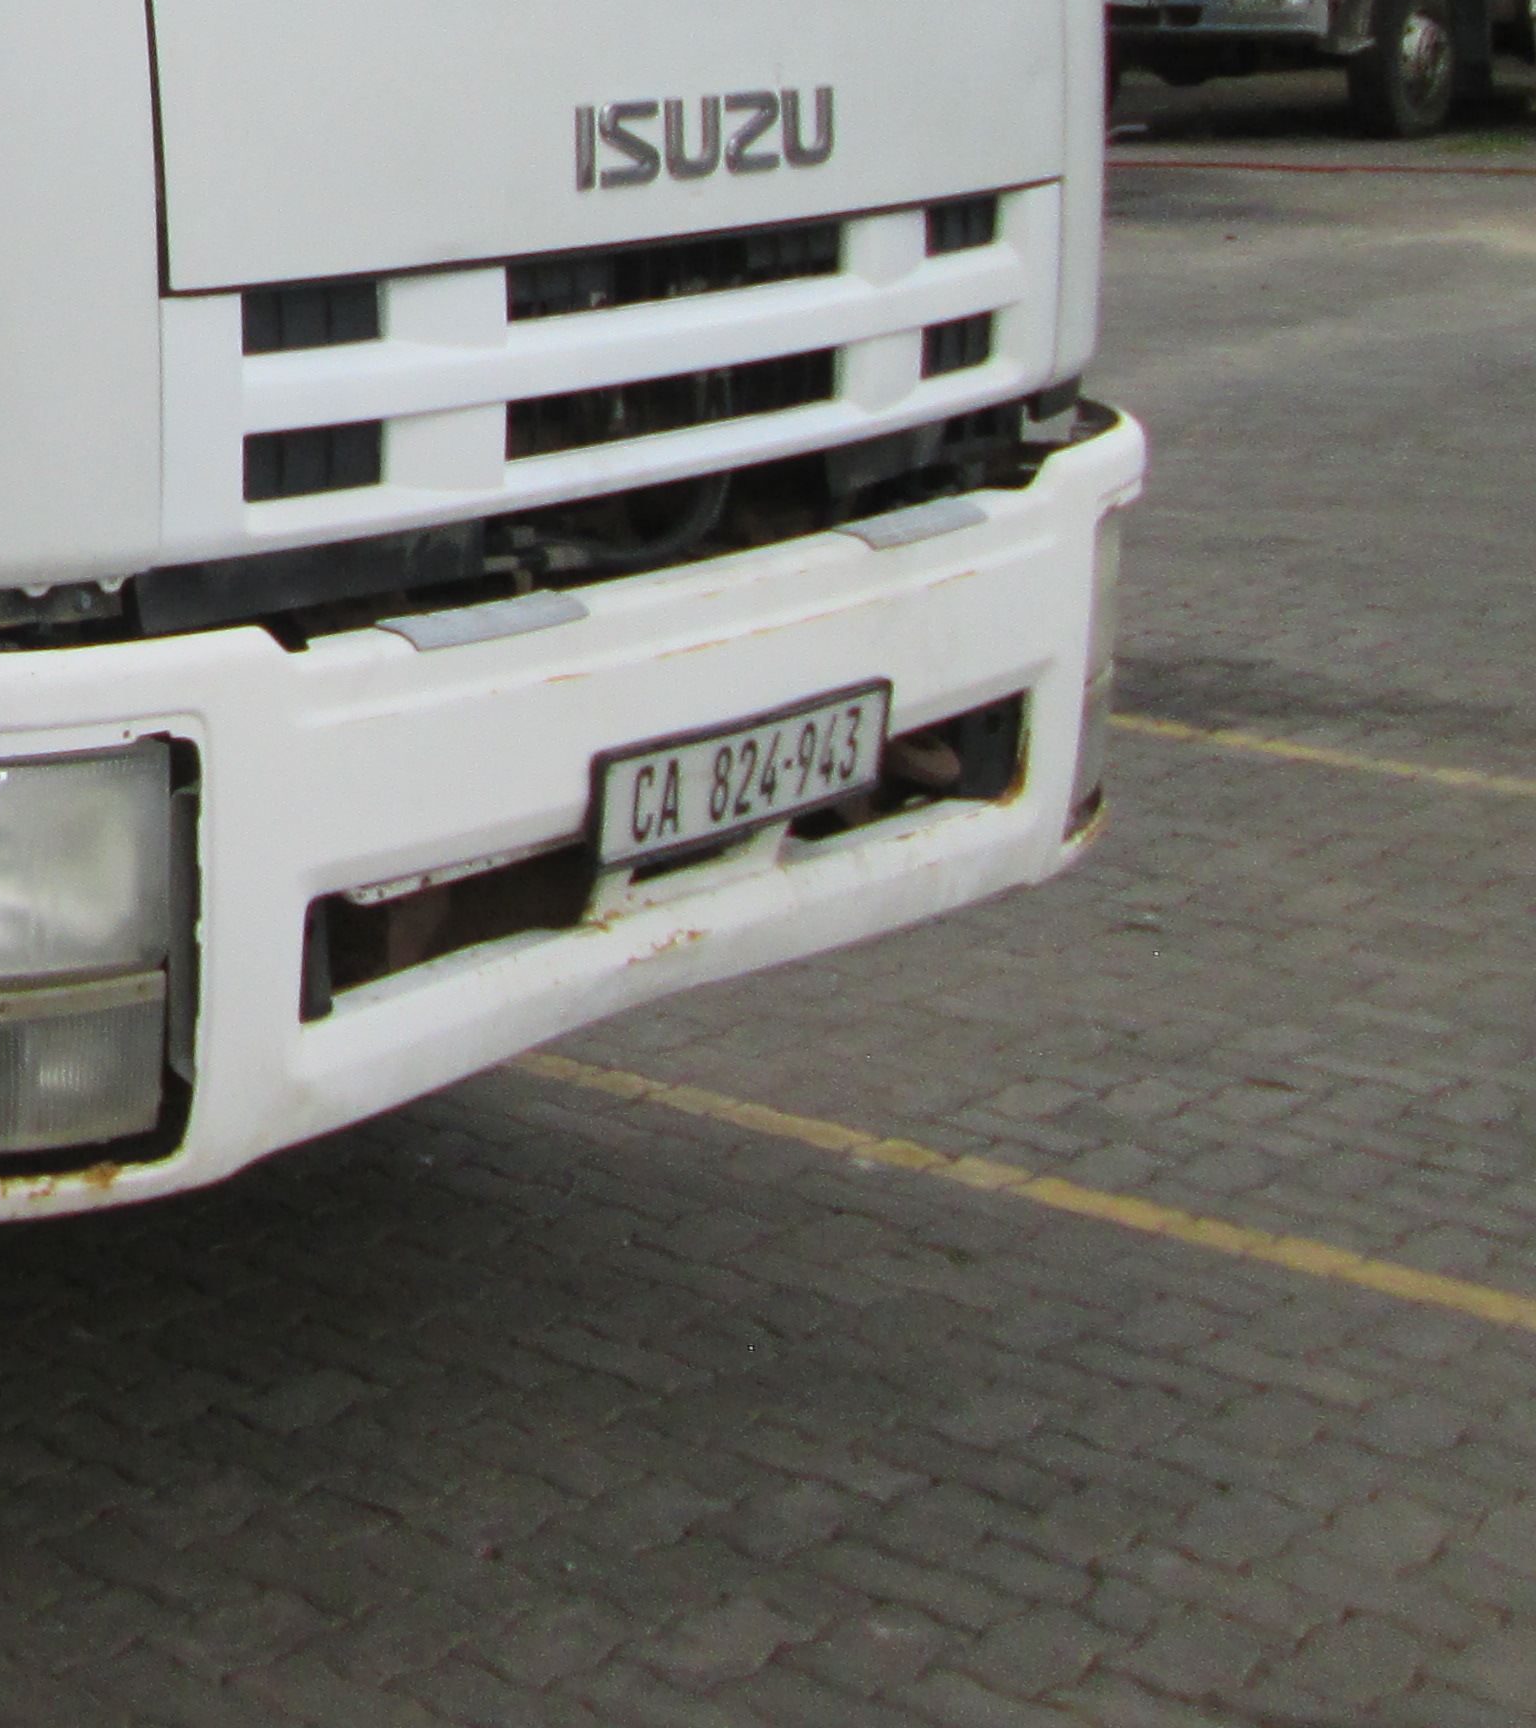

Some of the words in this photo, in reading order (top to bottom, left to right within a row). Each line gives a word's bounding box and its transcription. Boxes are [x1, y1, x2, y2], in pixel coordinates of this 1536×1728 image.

[574, 85, 835, 192] ISUZU
[631, 758, 680, 843] CA
[710, 706, 864, 822] 824-943
